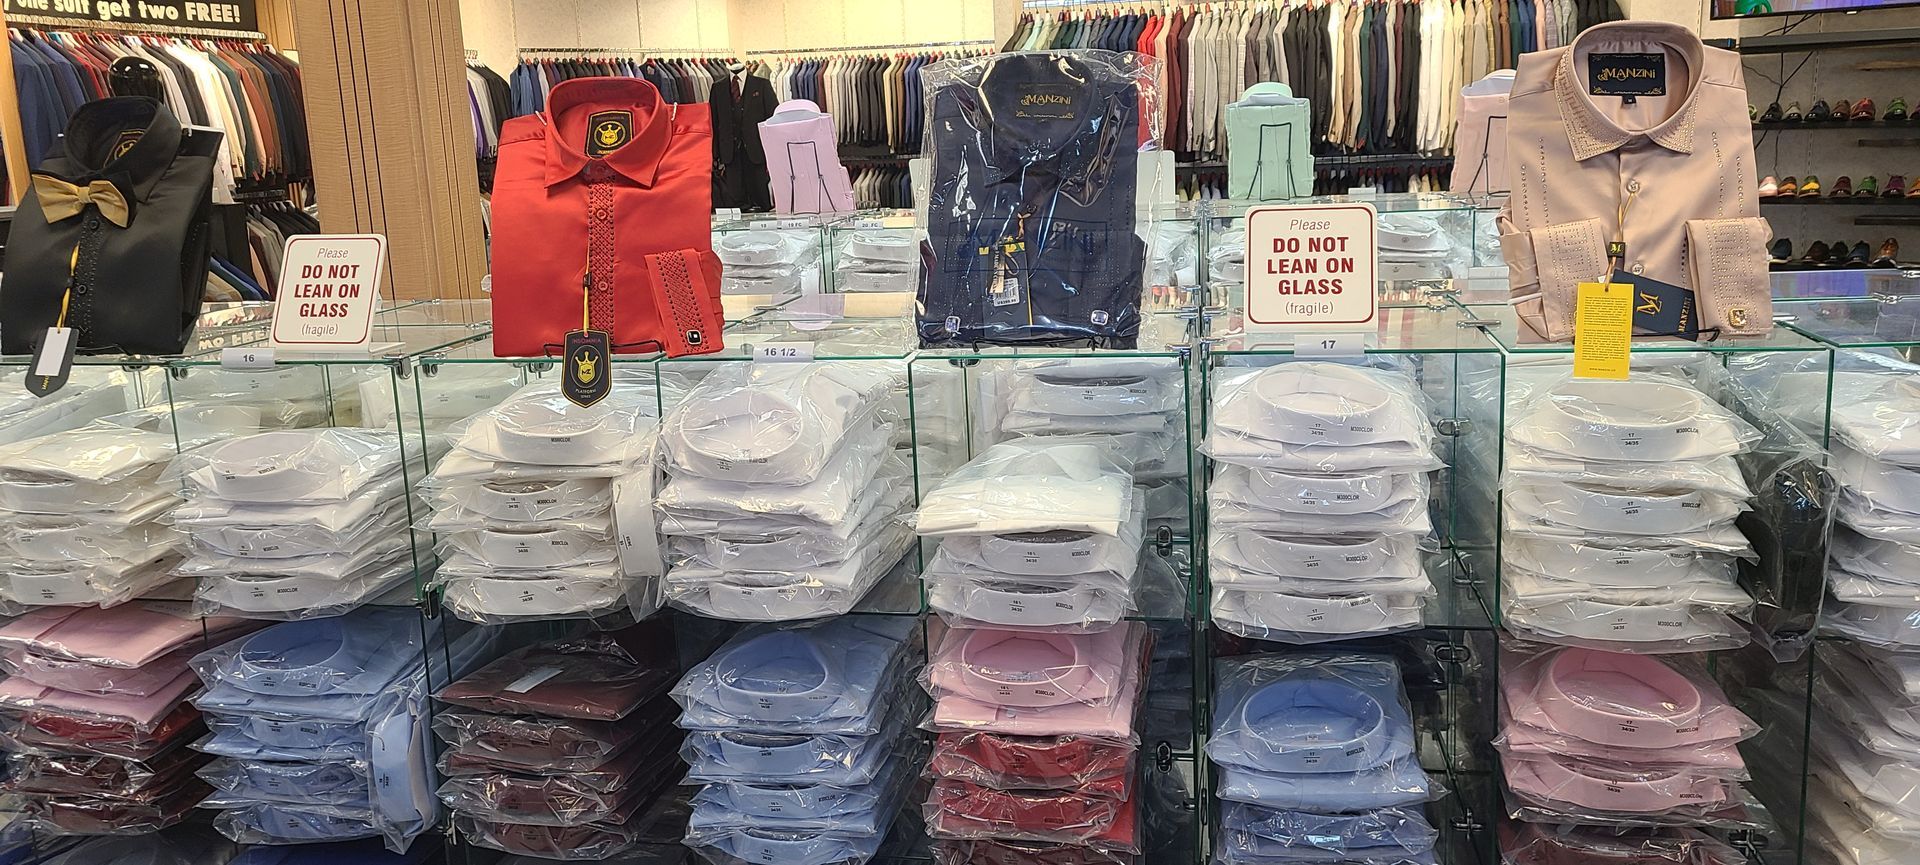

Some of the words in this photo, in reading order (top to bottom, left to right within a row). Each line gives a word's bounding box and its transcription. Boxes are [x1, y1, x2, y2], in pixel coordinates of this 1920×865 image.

[54, 0, 89, 14] suit
[97, 1, 130, 20] get
[138, 1, 179, 20] two
[186, 2, 241, 22] FREE!
[1289, 219, 1330, 230] Please
[1273, 238, 1300, 253] DO
[1308, 237, 1349, 252] NOT
[317, 248, 349, 258] Please
[301, 265, 322, 279] DO
[328, 264, 360, 278] NOT
[1267, 258, 1318, 274] LEAN
[1326, 258, 1354, 273] ON
[294, 284, 333, 298] LEAN
[338, 284, 360, 298] ON
[1278, 279, 1343, 295] GLASS
[300, 304, 348, 317] GLASS
[1285, 302, 1334, 316] (fragile)
[301, 323, 338, 337] (fragile)
[1321, 340, 1336, 349] 17
[764, 348, 777, 356] 16
[781, 348, 796, 356] 1/2
